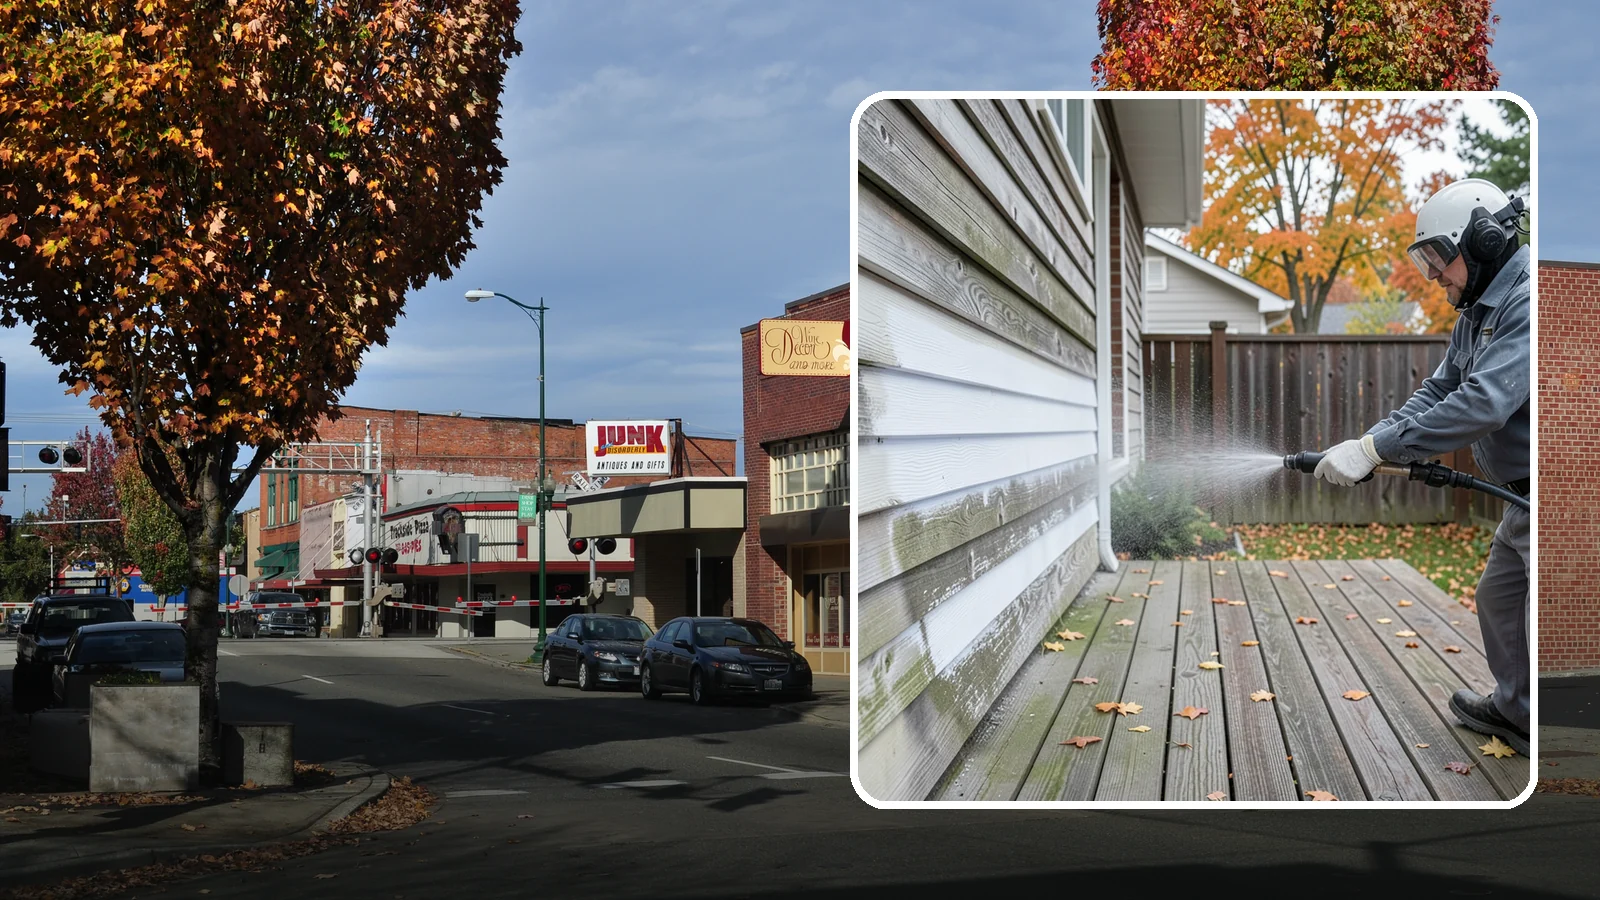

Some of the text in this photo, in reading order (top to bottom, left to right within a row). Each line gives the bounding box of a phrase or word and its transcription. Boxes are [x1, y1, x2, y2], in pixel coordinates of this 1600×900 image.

[595, 425, 665, 457] JUNK
[608, 446, 645, 454] DISORDERLY
[597, 460, 665, 470] ANTIQUES AND GIFTS
[390, 519, 429, 540] Trackside Pizza
